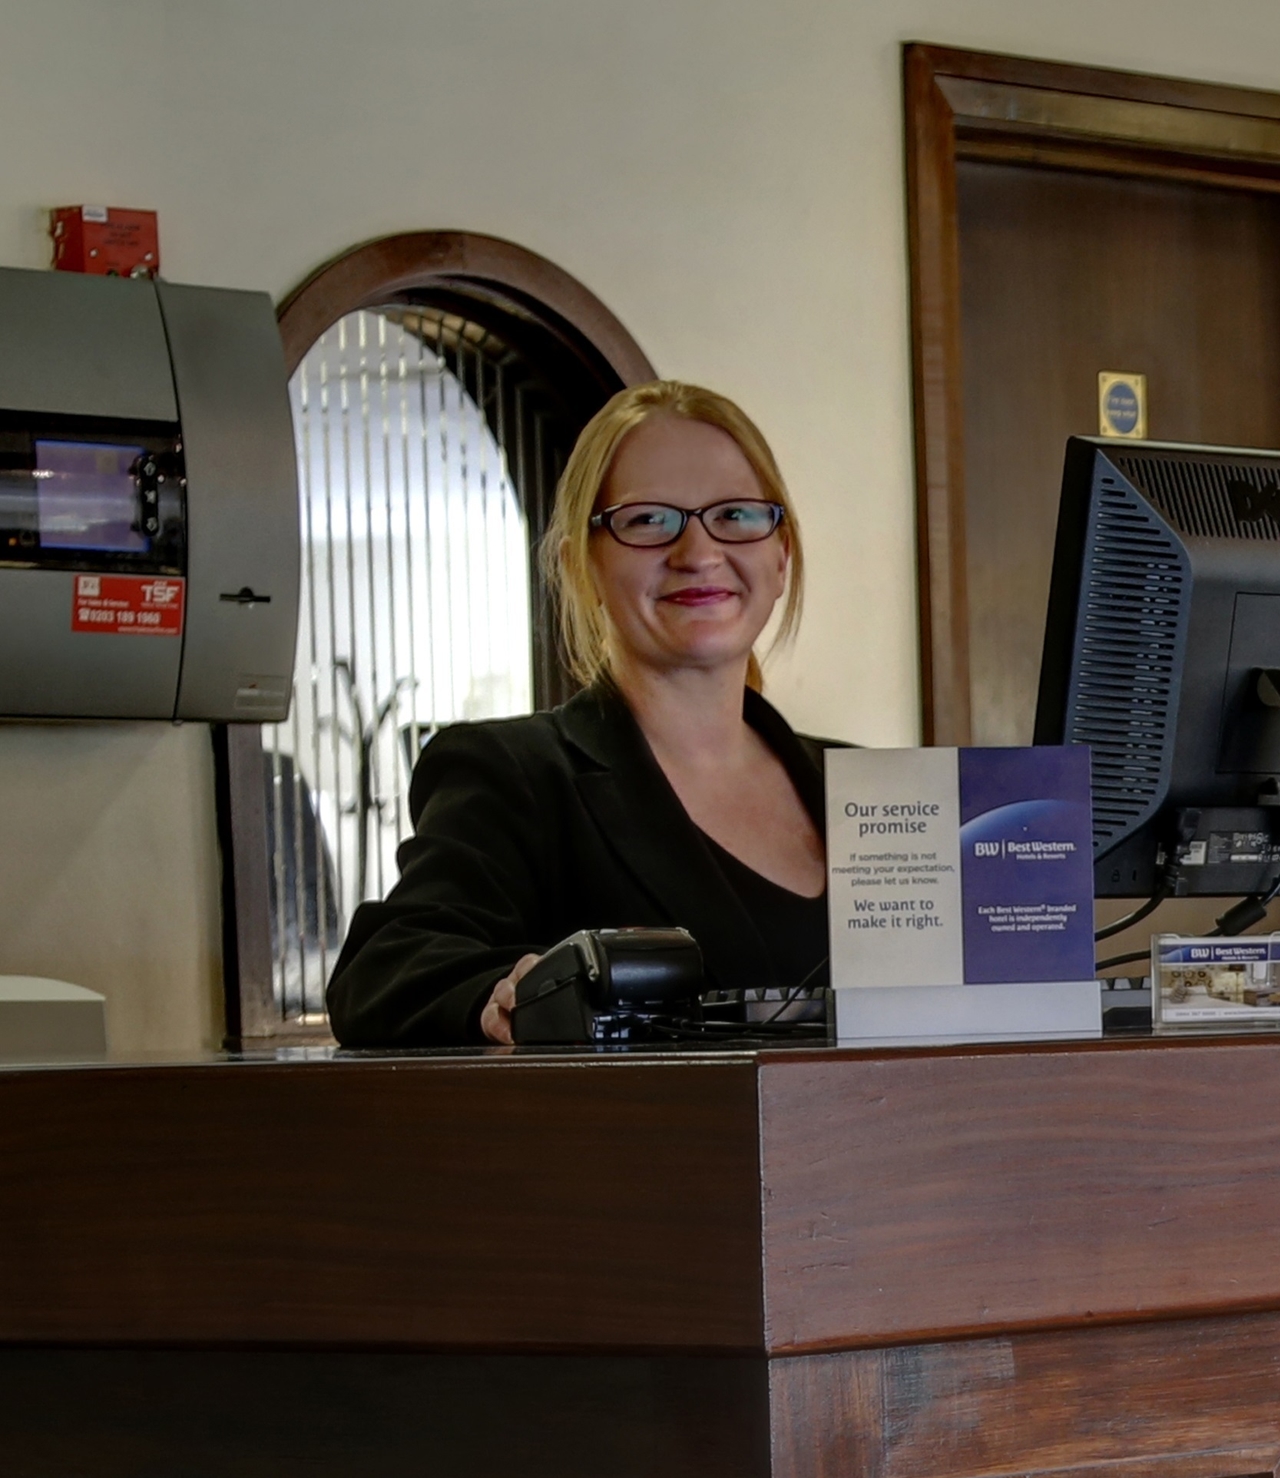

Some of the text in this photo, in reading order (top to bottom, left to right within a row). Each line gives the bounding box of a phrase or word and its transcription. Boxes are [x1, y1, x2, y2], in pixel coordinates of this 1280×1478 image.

[141, 584, 180, 603] TSF
[844, 801, 940, 817] Our service
[859, 818, 927, 838] promise
[974, 842, 1000, 857] BW
[1007, 841, 1031, 852] Best
[849, 851, 937, 862] If something is not
[832, 863, 955, 875] meeting your expectation,
[851, 878, 882, 887] please
[884, 876, 896, 885] let
[912, 876, 939, 885] know.
[853, 899, 934, 912] We want to
[978, 906, 996, 914] Each
[996, 905, 1012, 914] Best
[1047, 904, 1077, 913] branded
[847, 914, 943, 930] make it right.
[989, 915, 1007, 923] hotel
[1016, 914, 1067, 923] independently
[991, 924, 1016, 932] owned
[1190, 948, 1209, 959] BW
[1215, 947, 1233, 955] Best
